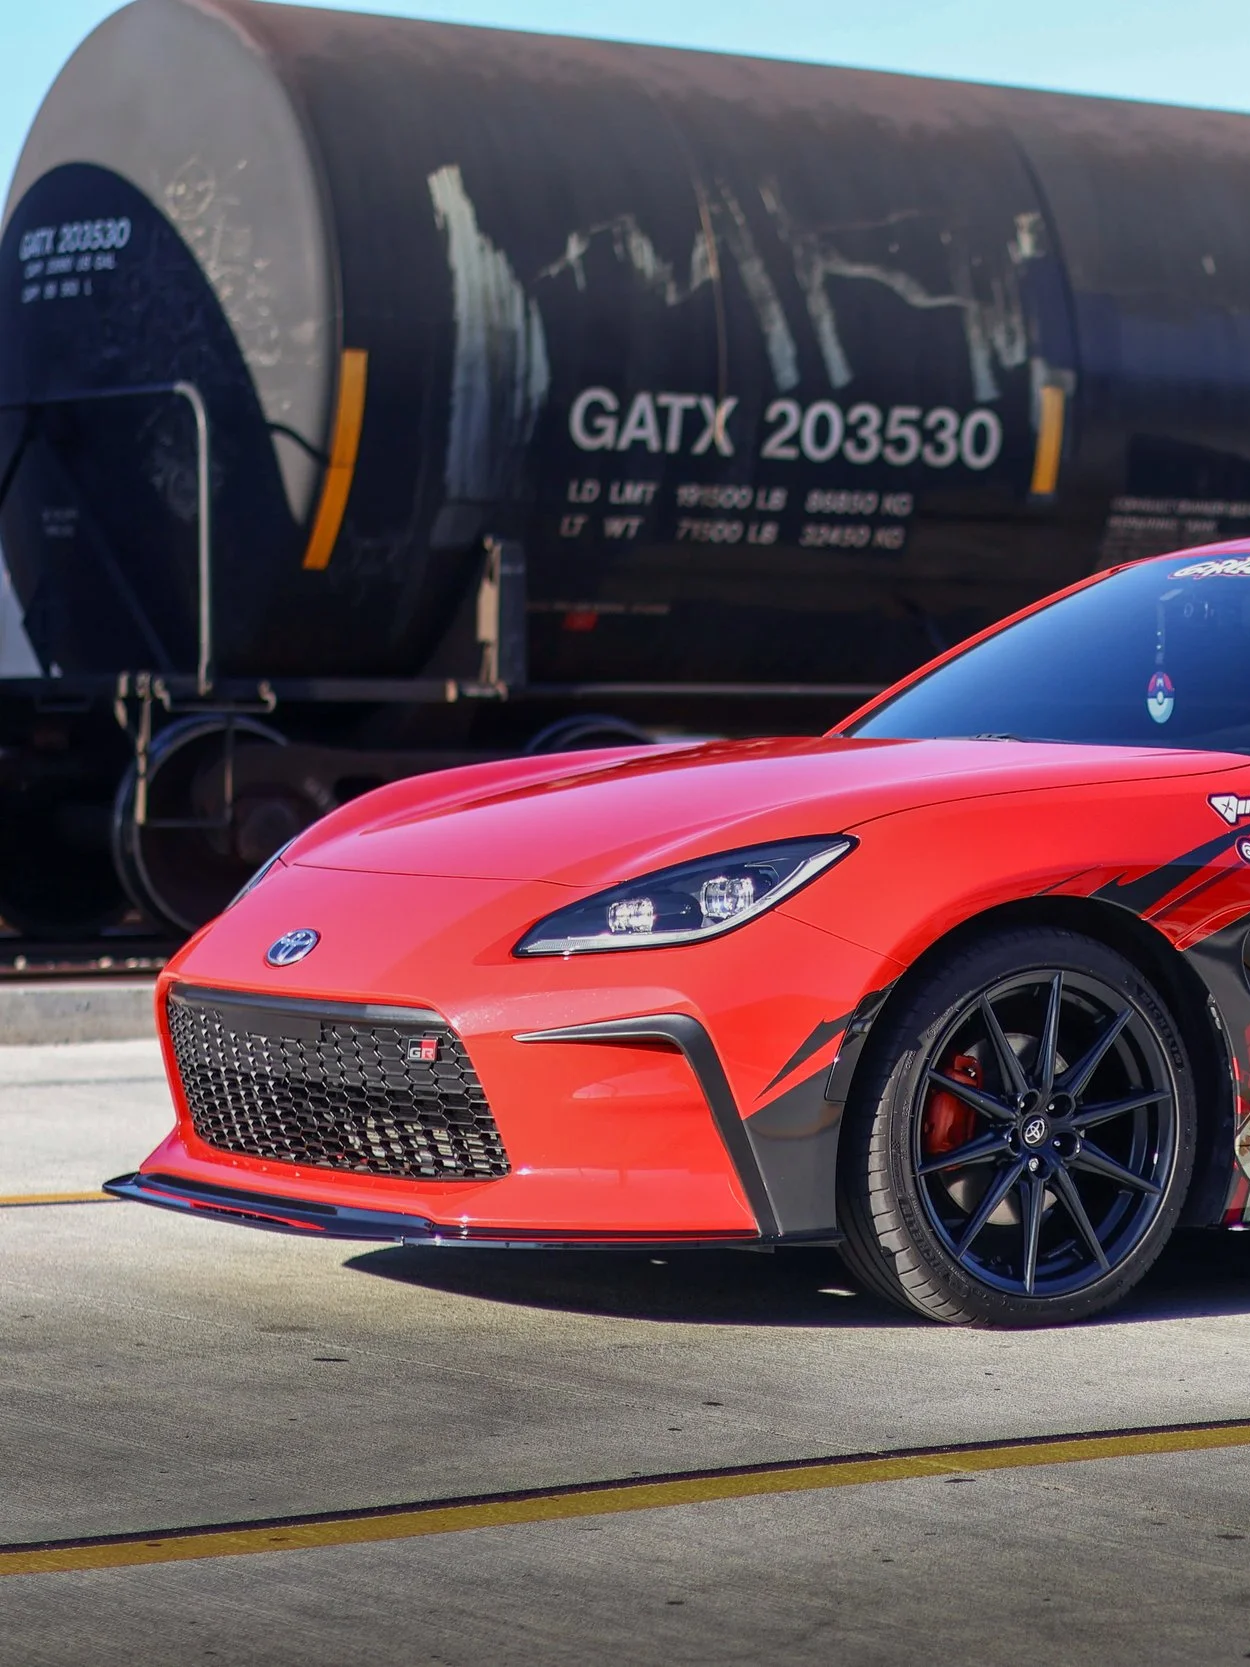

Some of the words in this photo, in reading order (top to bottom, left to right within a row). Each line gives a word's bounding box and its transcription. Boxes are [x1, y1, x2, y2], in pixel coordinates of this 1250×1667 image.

[569, 386, 739, 457] GATX
[761, 398, 1003, 470] 203530
[567, 479, 600, 503] LD
[609, 481, 659, 505] LMT
[755, 486, 788, 511] LB
[559, 514, 588, 539] LT
[602, 515, 645, 540] WT
[746, 520, 780, 545] LB
[409, 1047, 435, 1060] GR
